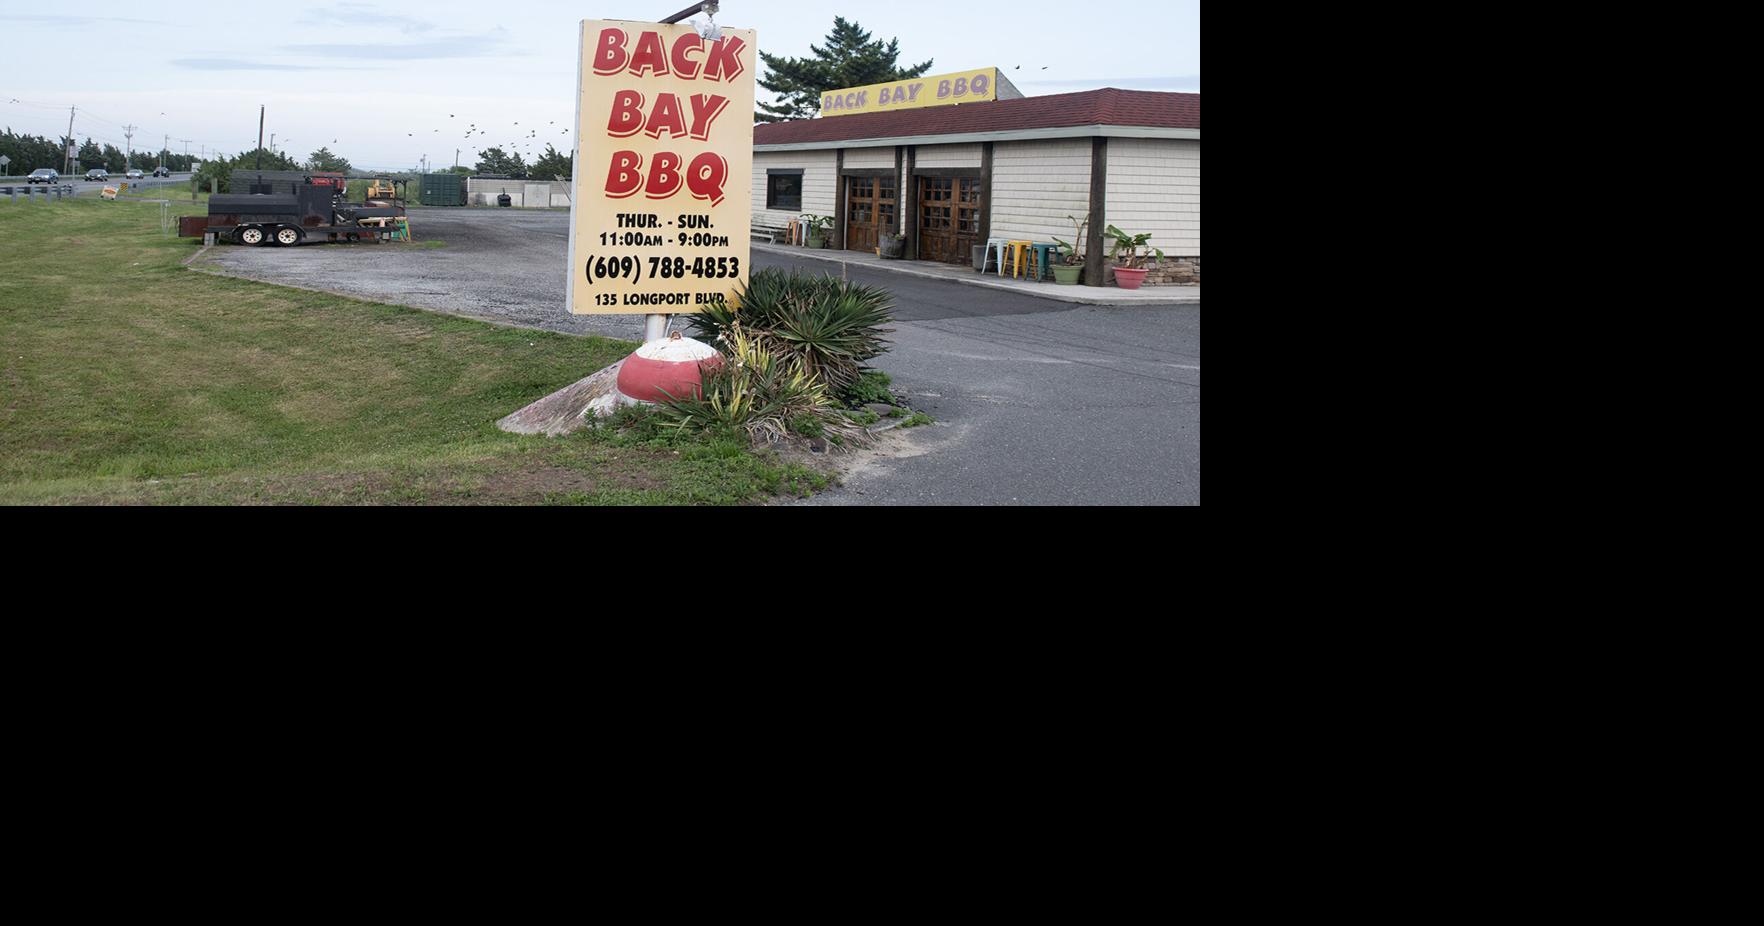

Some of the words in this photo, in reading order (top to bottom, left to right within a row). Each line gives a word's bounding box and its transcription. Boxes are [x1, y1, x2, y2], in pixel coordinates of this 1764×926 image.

[593, 28, 746, 83] BACK
[823, 90, 868, 112] BACK
[879, 83, 923, 106] BAY
[936, 74, 991, 99] BBQ
[607, 90, 730, 141] BAY
[605, 150, 729, 207] BBQ
[616, 213, 663, 228] THUR.
[677, 214, 714, 228] SUN.
[599, 231, 663, 246] 11:00AM
[678, 232, 729, 246] 9:00PM
[585, 254, 641, 285] (609)
[648, 256, 739, 278] 788-4853
[595, 293, 617, 305] 135
[623, 293, 690, 305] LONGPORT
[695, 292, 728, 304] BLVD.
